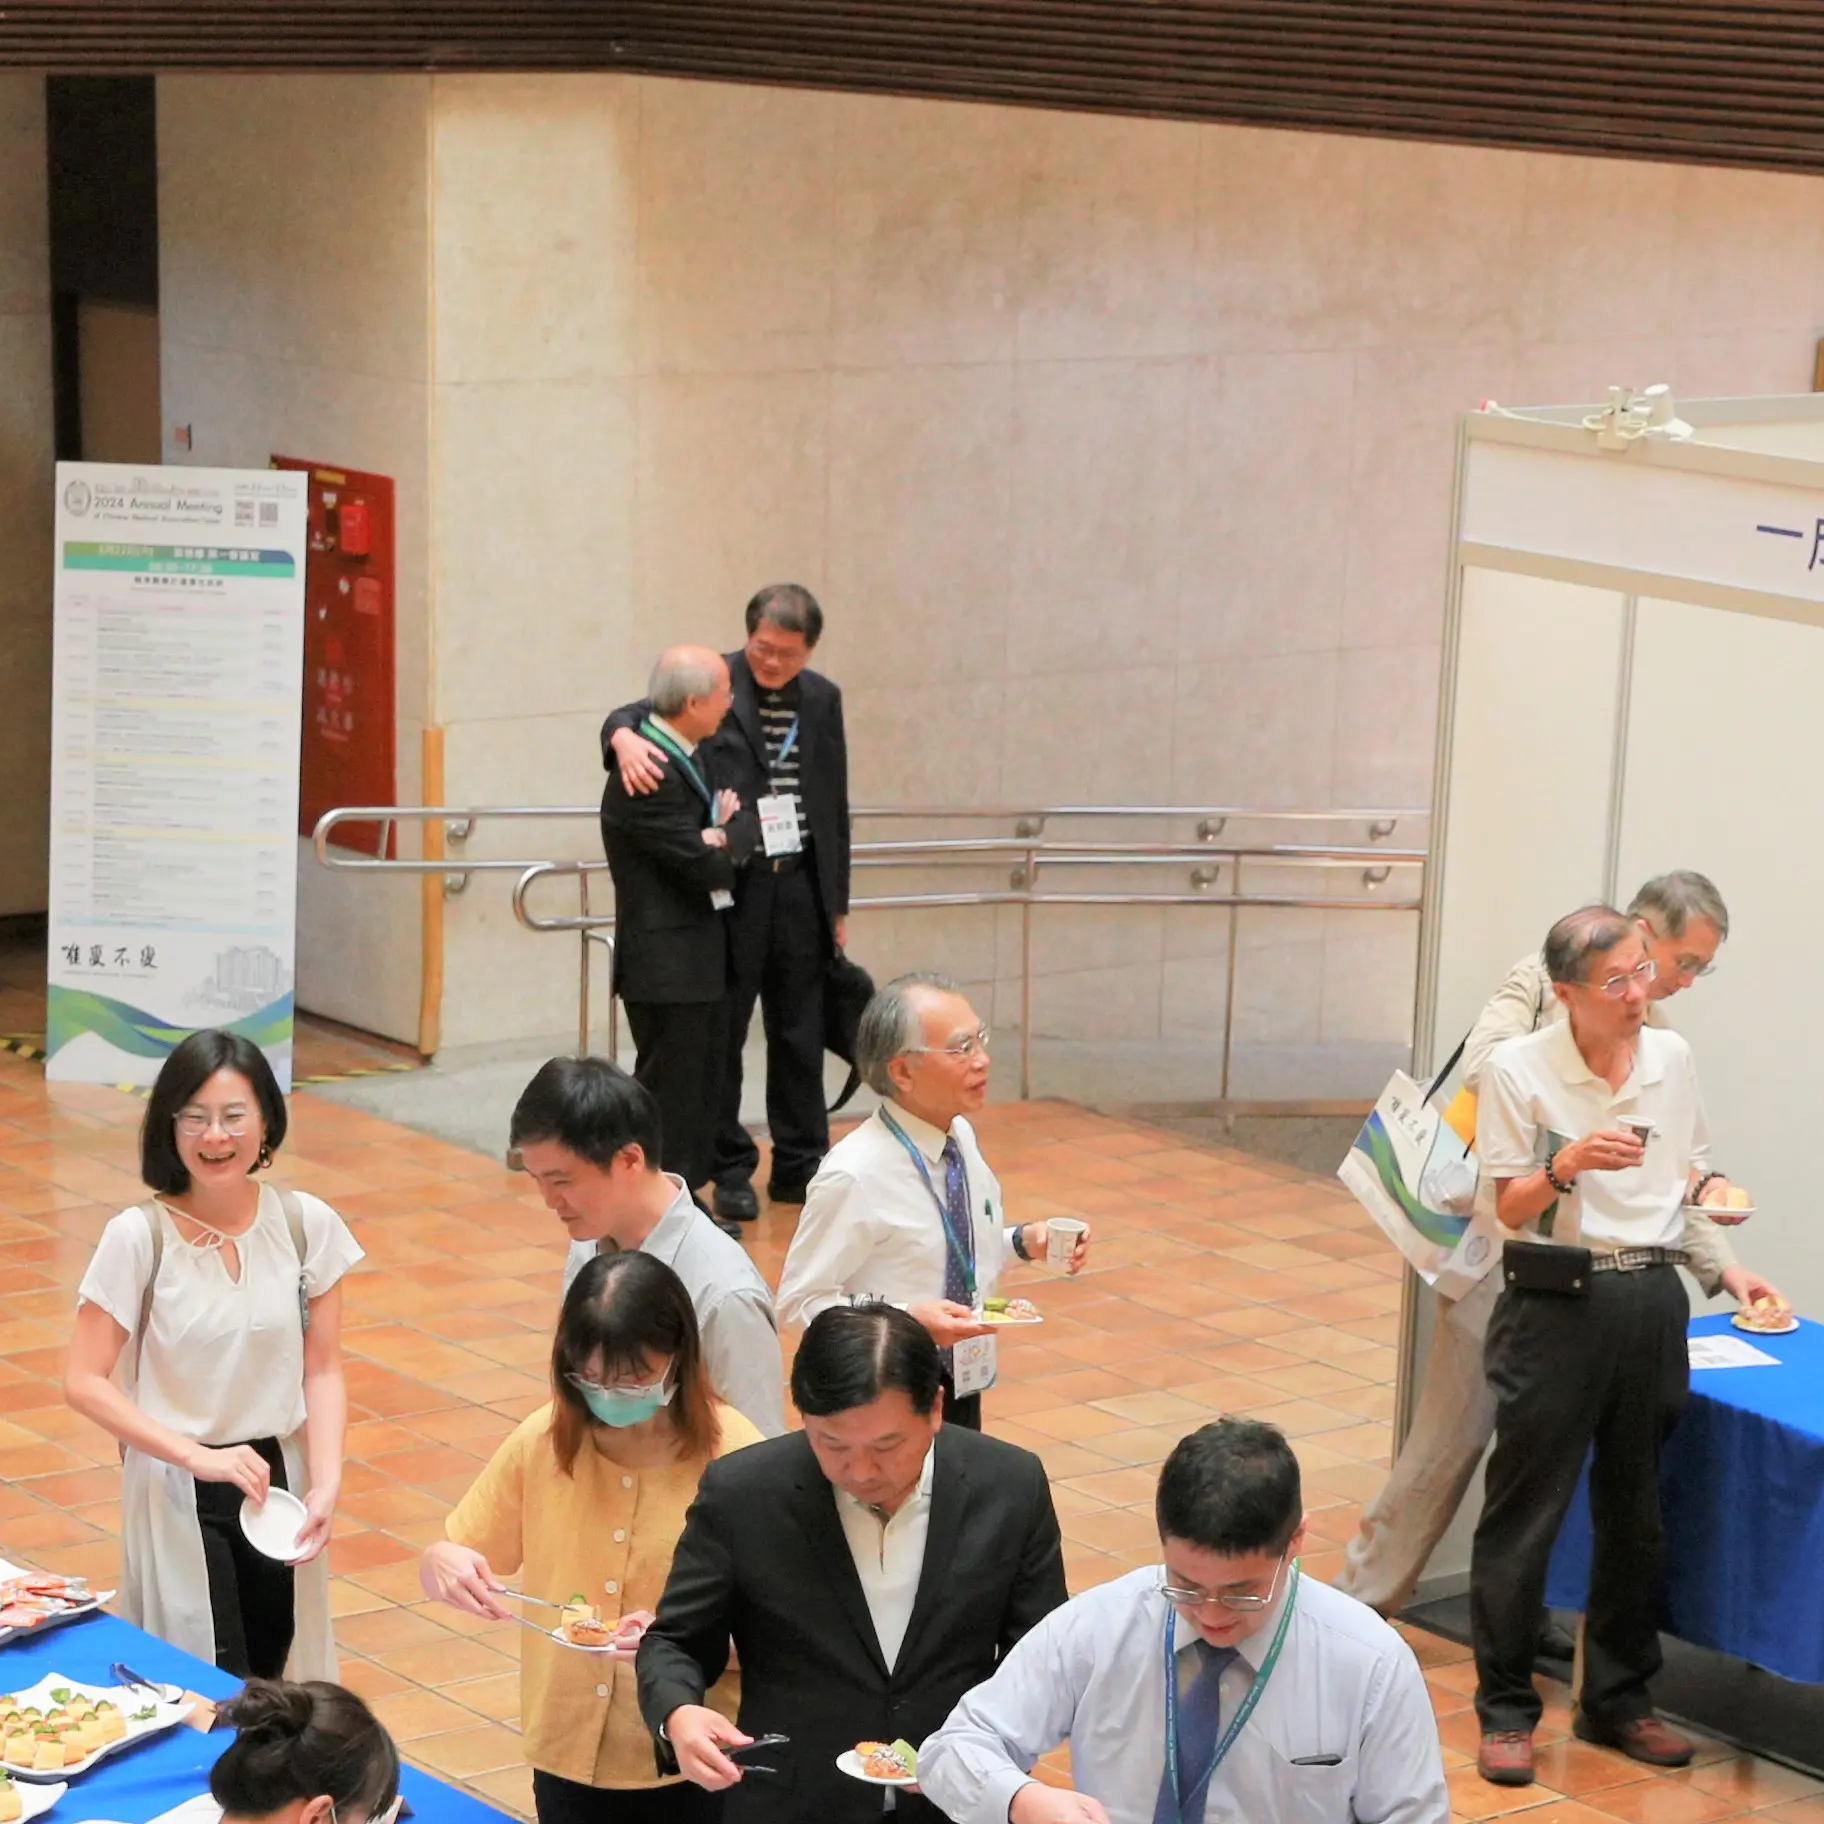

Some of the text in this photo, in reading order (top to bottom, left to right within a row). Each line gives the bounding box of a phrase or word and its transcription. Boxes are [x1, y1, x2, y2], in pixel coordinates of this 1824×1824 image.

[94, 497, 223, 515] 2024 Annual Meeting
